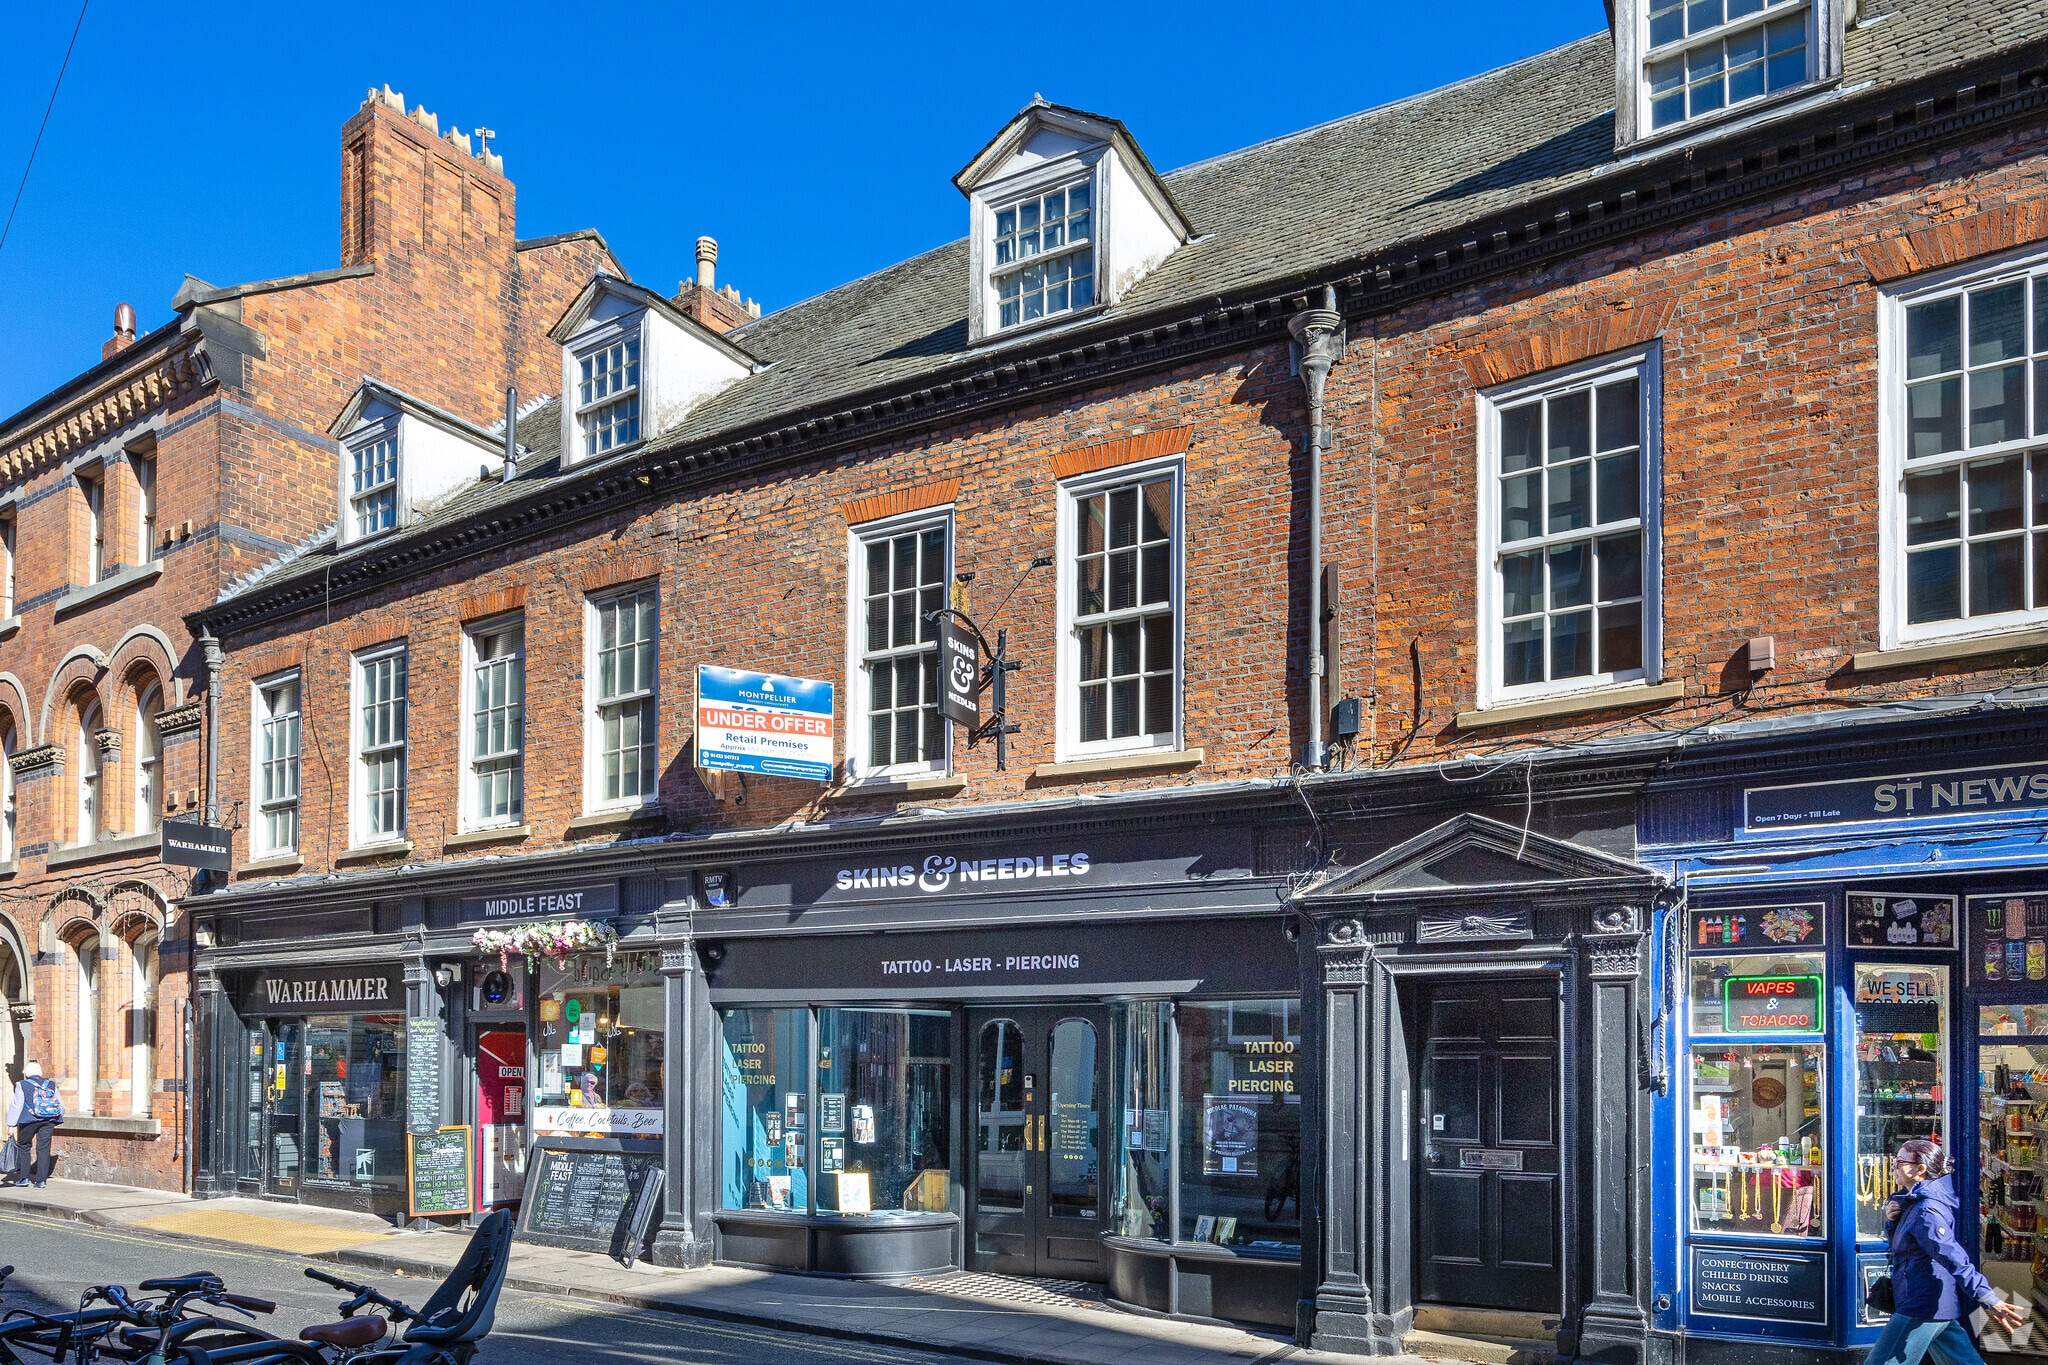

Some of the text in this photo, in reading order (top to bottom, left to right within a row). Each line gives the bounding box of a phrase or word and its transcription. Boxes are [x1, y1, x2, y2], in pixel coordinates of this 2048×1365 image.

[947, 636, 975, 660] SKINS
[950, 655, 975, 694] &
[738, 690, 797, 704] MONTPELLIER
[948, 690, 977, 712] NEEDLES
[706, 710, 767, 729] UNDER
[771, 716, 826, 734] OFFER
[720, 742, 746, 751] Approx
[726, 732, 809, 750] Retail Premises
[1874, 773, 2048, 812] ST NEWS
[1755, 814, 1776, 823] Open
[1783, 812, 1802, 822] Days
[1809, 810, 1821, 818] Till
[1822, 809, 1840, 817] Late
[167, 838, 228, 854] WARHAMMER
[704, 874, 723, 884] RMTV
[836, 853, 1090, 892] SKINS & NEEDLES
[485, 892, 584, 916] MIDDLE FEAST
[881, 959, 932, 974] TATTOO
[945, 958, 992, 972] LASER
[1005, 954, 1080, 970] PIERCING
[266, 978, 388, 1003] WARHAMMER
[1747, 981, 1796, 994] VAPES
[1867, 981, 1891, 996] WE
[1896, 981, 1934, 997] SELL
[1766, 997, 1779, 1010] &
[1741, 1014, 1809, 1026] TOBACCO
[732, 1043, 766, 1054] TATTOO
[1243, 1041, 1295, 1054] TATTOO
[732, 1059, 762, 1069] LASER
[1249, 1060, 1294, 1073] LASER
[501, 1067, 522, 1077] OPEN
[731, 1074, 776, 1085] PIERCING
[1228, 1079, 1294, 1092] PIERCING
[1206, 1104, 1228, 1115] NICOLAS
[631, 1112, 658, 1129] Beer
[550, 1161, 575, 1172] MIDDLE
[550, 1171, 573, 1181] FEAST
[1701, 1258, 1790, 1272] CONFECTIONERY
[1701, 1270, 1789, 1284] CHILLED DRINKS
[1701, 1281, 1742, 1292] SNACKS
[1702, 1293, 1815, 1310] MOBILE ACCESSORIES
